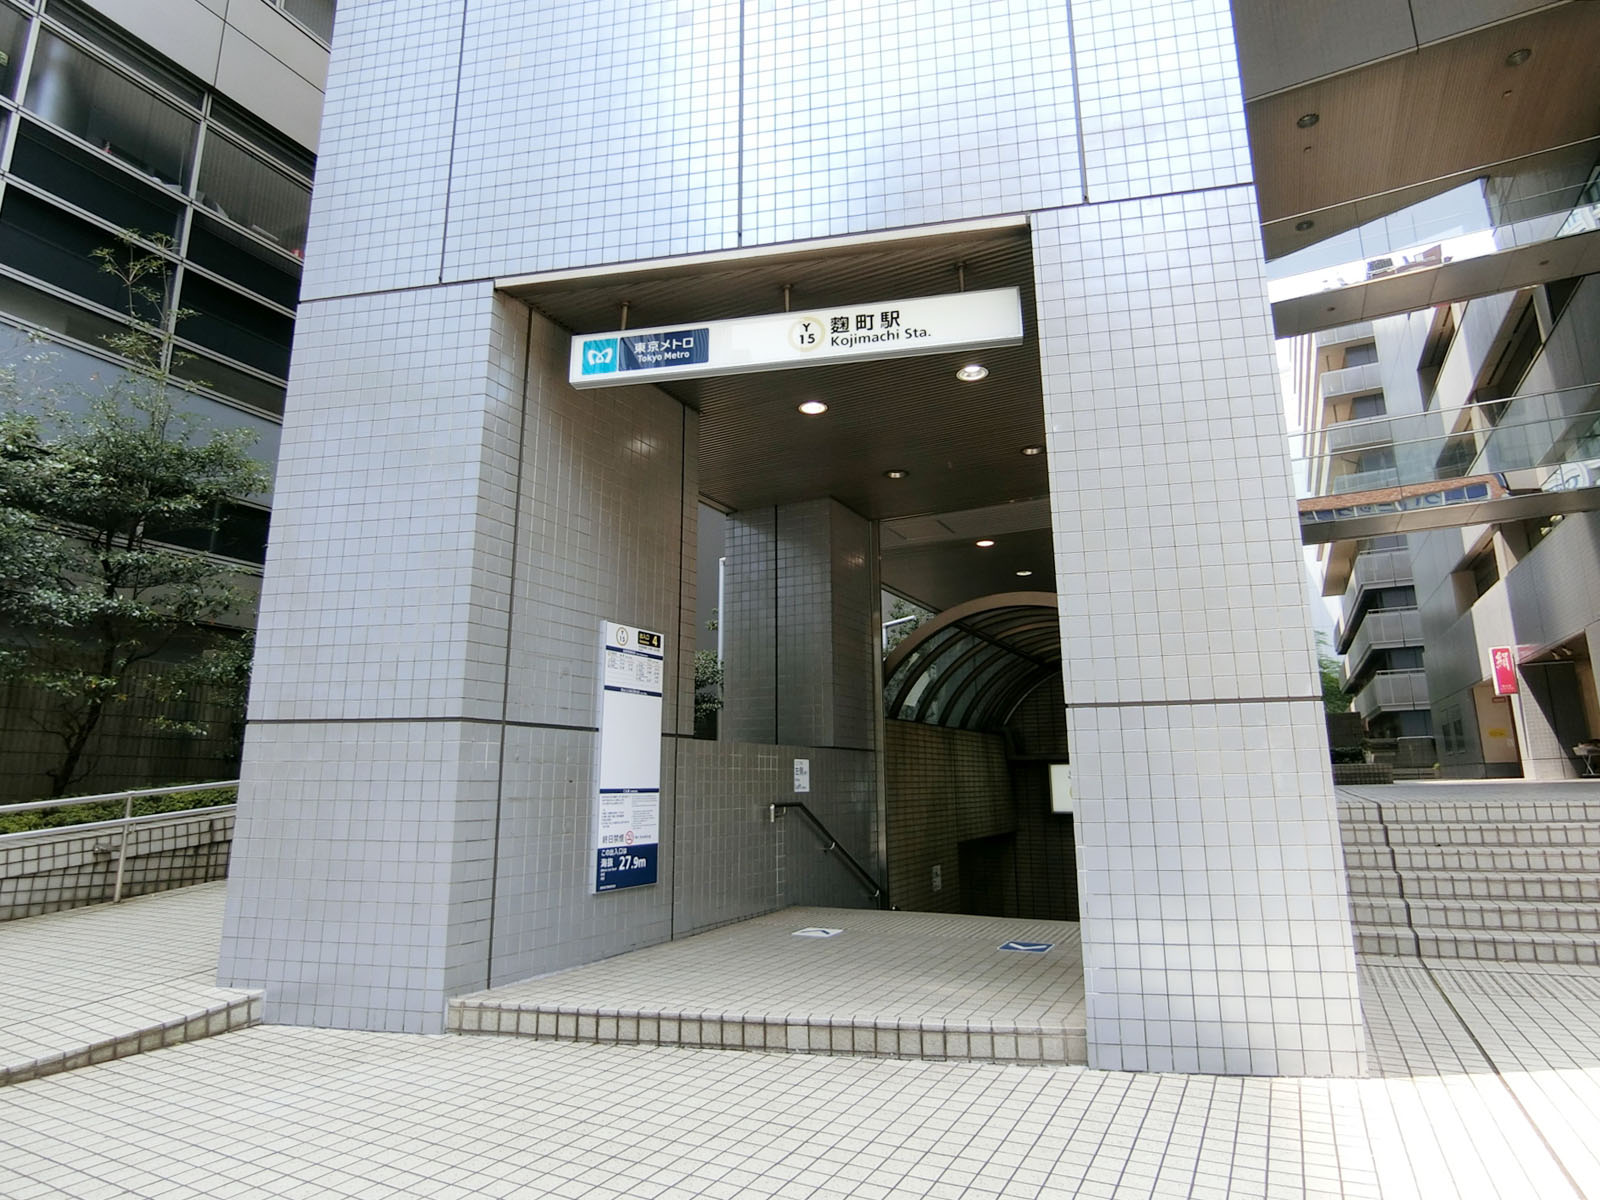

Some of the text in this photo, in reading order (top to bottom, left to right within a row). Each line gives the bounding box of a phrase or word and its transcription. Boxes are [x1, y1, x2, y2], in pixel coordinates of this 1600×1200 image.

[803, 323, 811, 332] Y
[800, 333, 816, 345] 15
[831, 327, 931, 348] Kojimachi Sta.
[633, 337, 694, 354] 東京メトロ
[637, 350, 690, 363] Tokyo Metro
[618, 855, 647, 871] 27.9m
